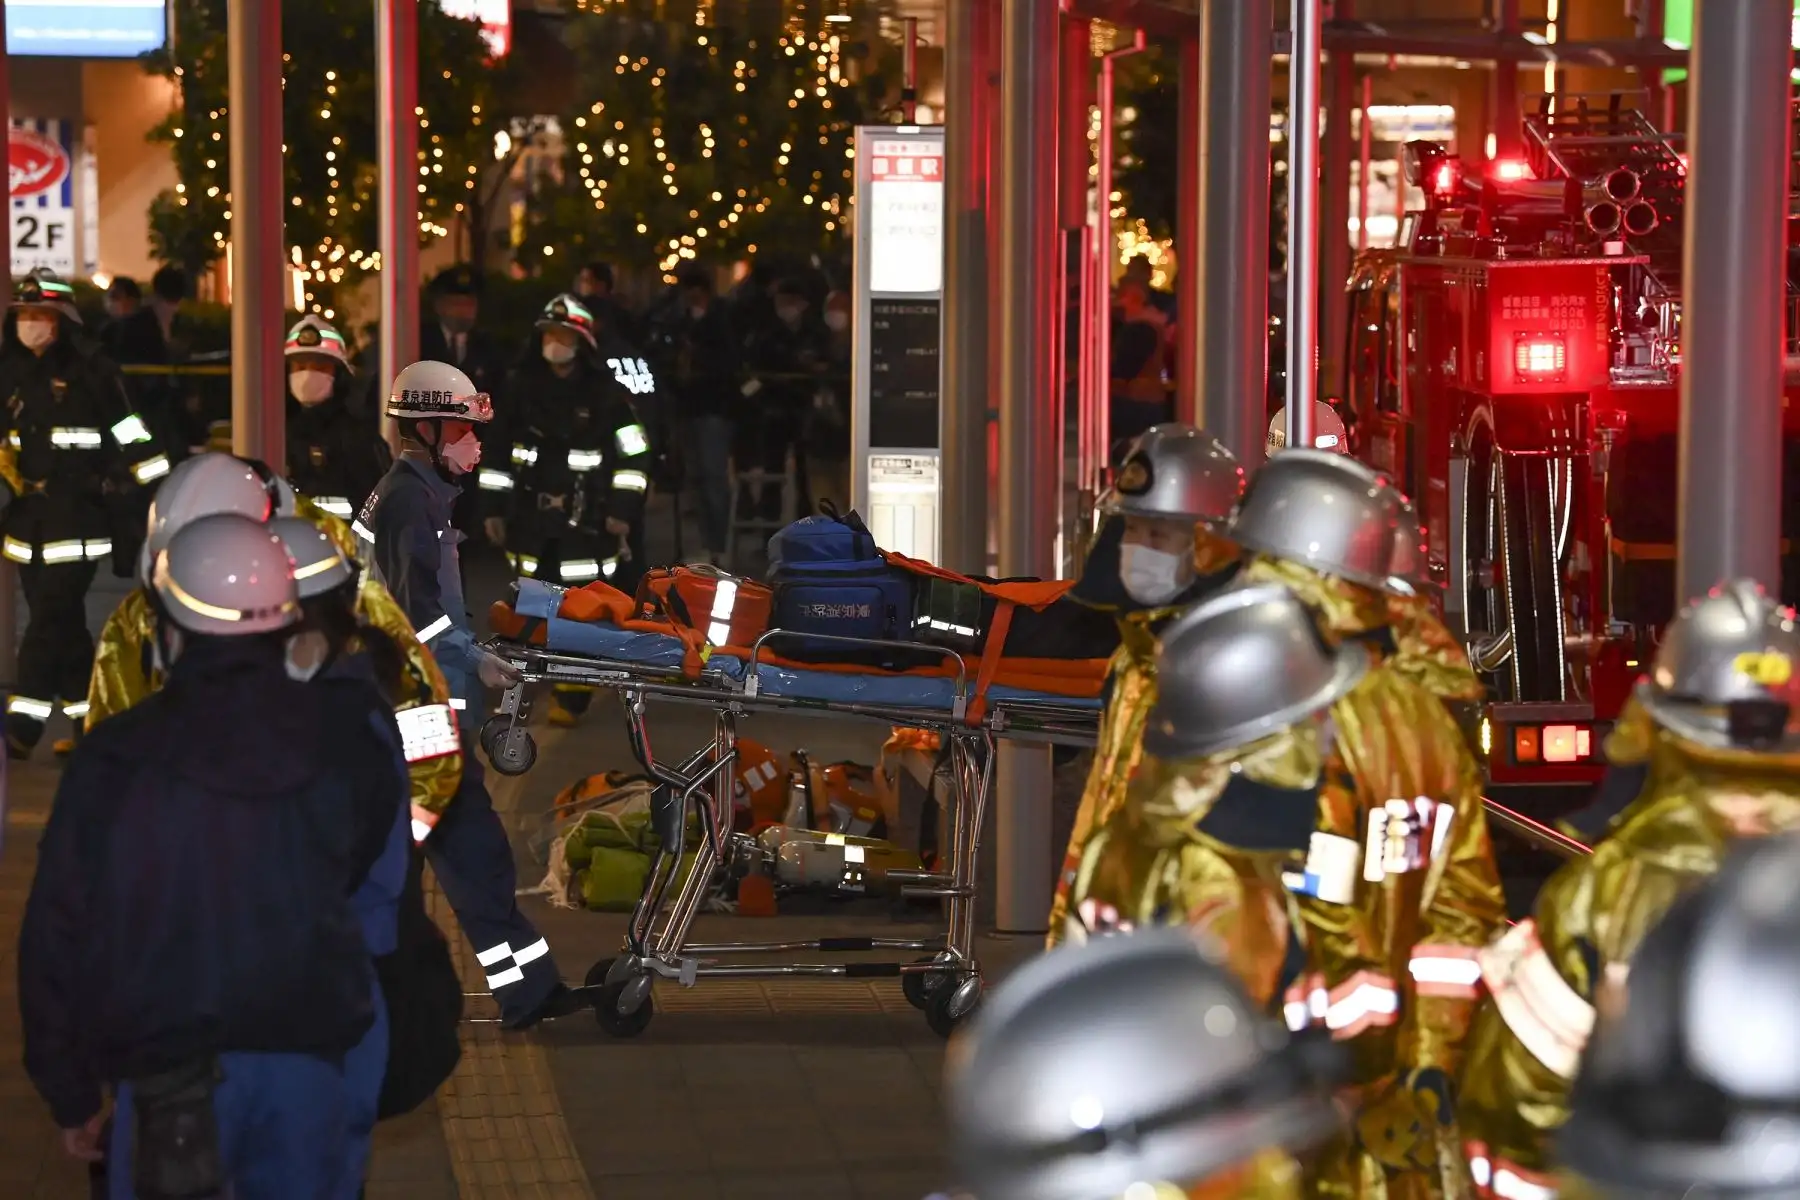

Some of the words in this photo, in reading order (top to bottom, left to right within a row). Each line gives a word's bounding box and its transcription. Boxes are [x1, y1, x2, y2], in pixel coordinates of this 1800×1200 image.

[16, 216, 64, 249] 2F
[401, 389, 452, 404] 東京消防庁
